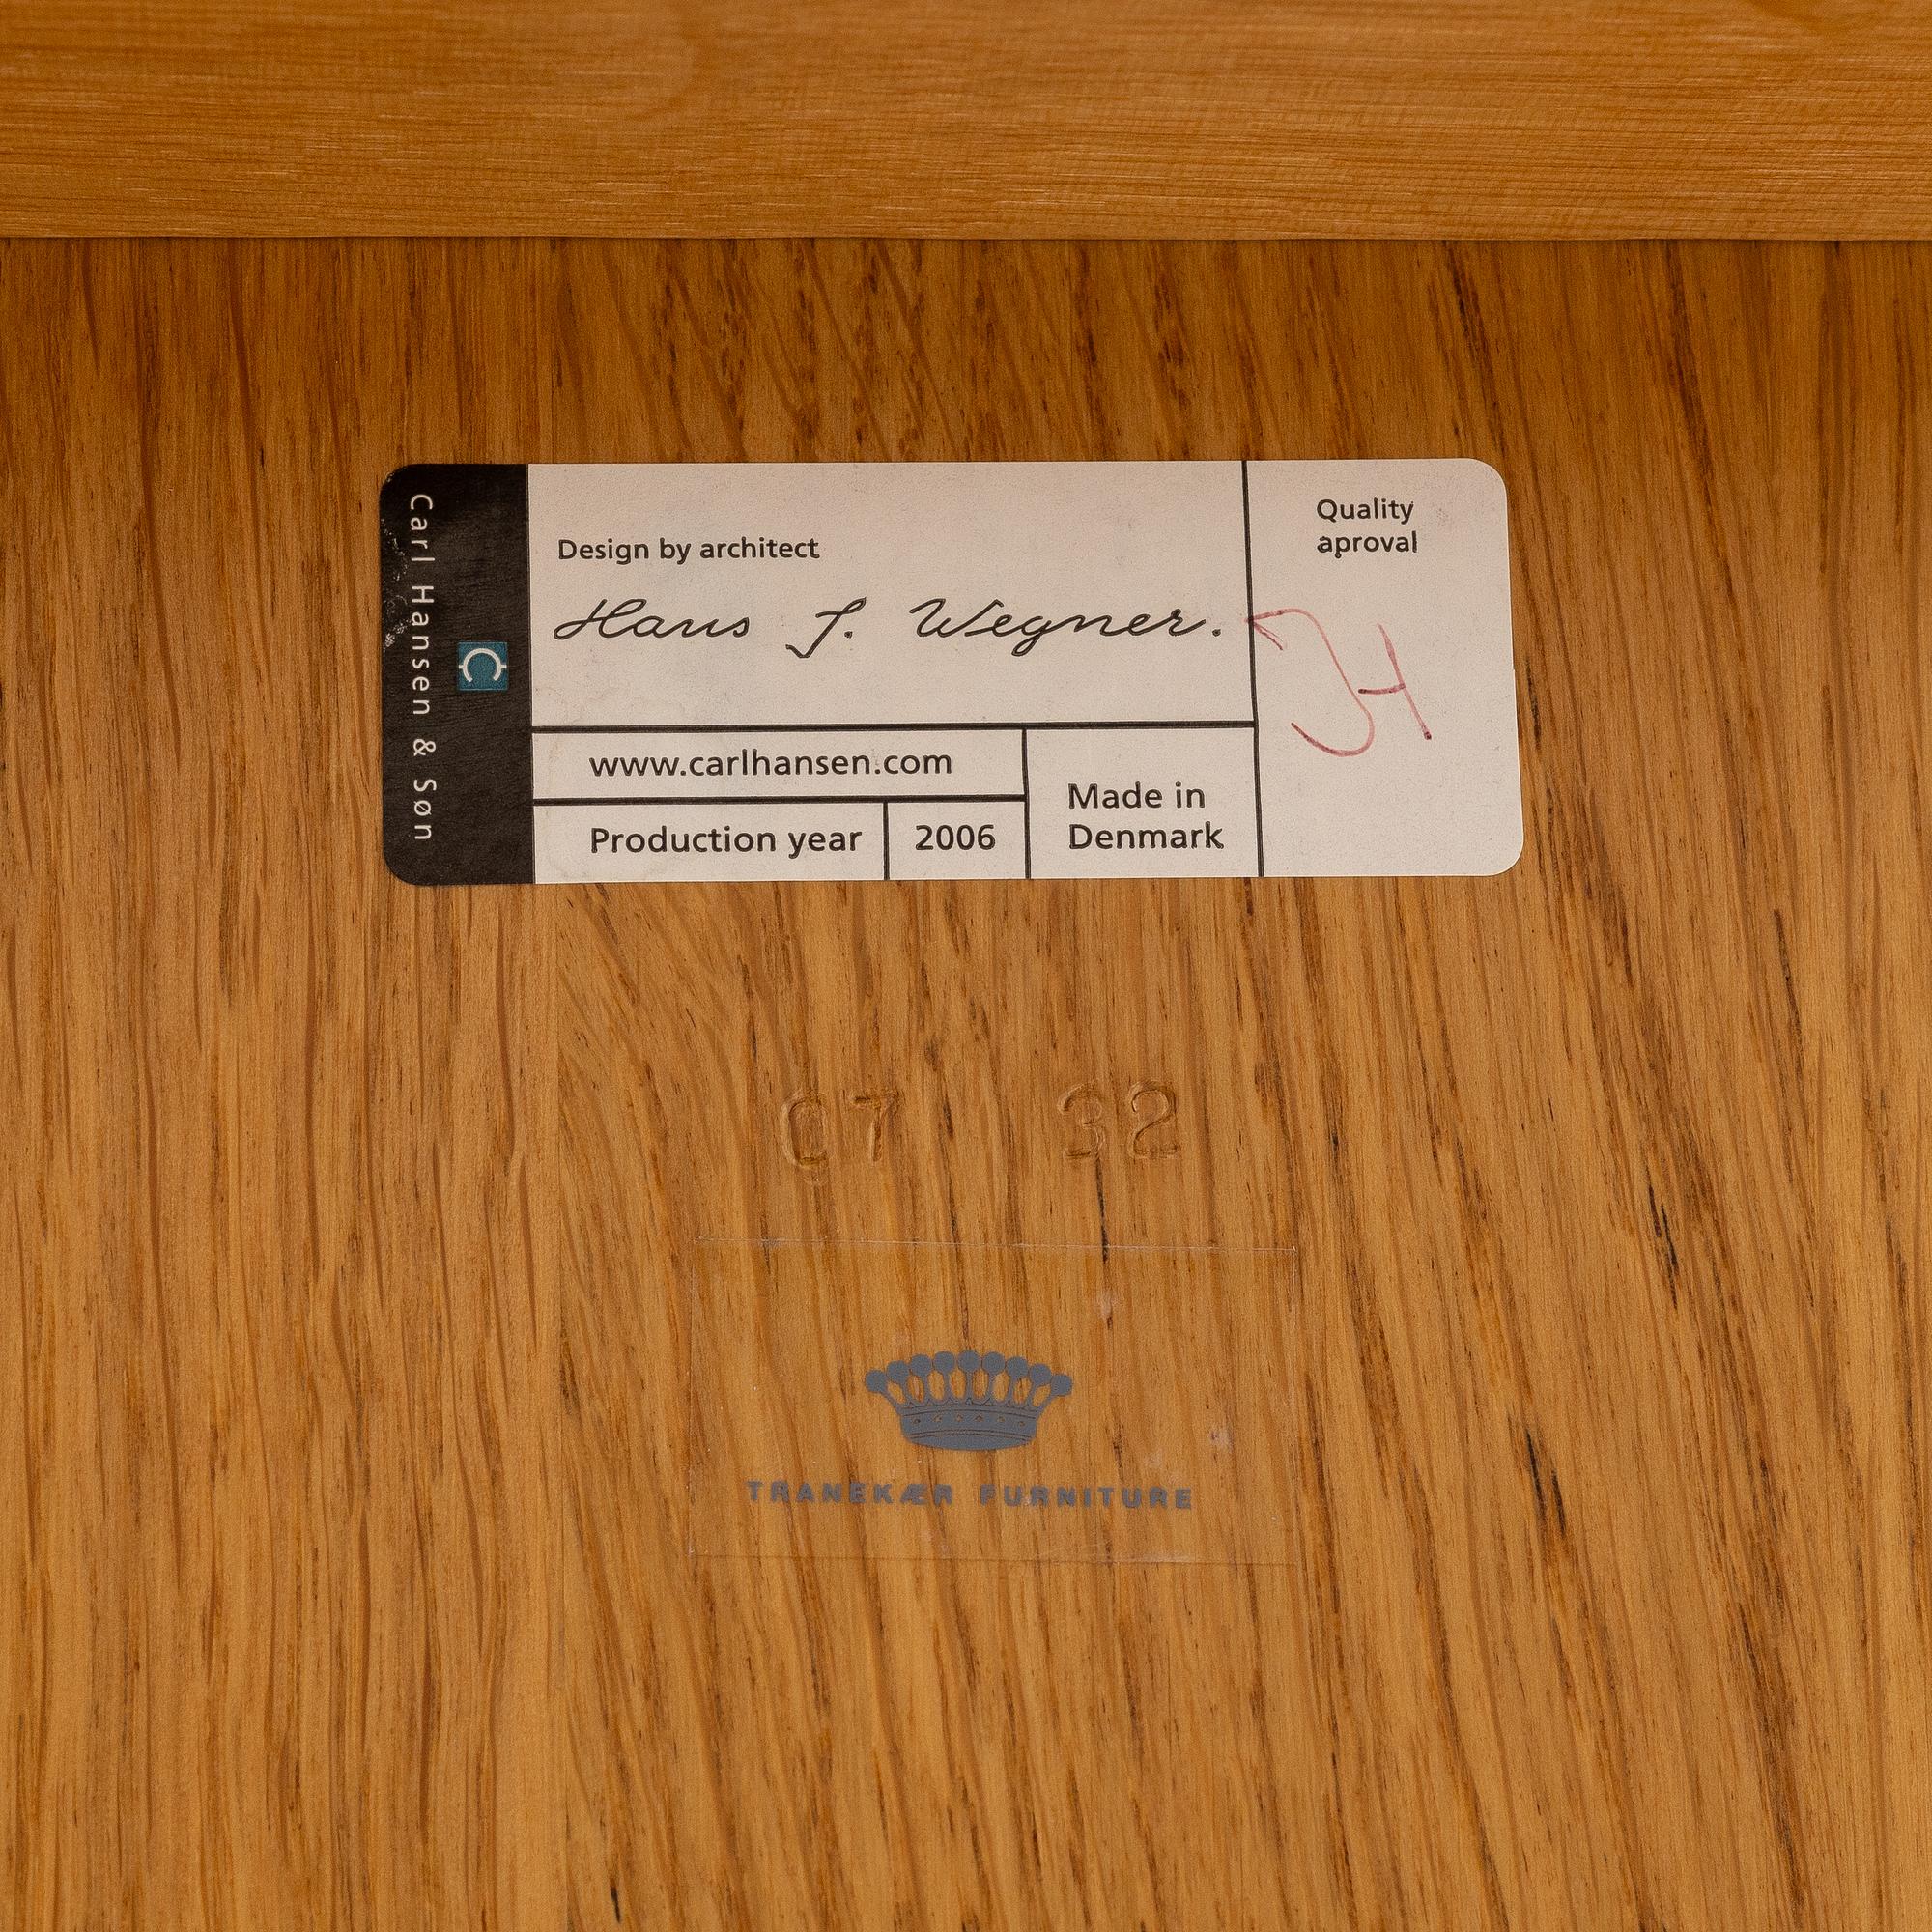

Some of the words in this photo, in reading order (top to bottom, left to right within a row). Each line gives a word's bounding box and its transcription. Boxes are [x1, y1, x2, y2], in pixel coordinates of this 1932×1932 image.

[1315, 496, 1415, 526] Quality
[409, 493, 436, 563] Carl
[557, 537, 650, 566] Design
[658, 536, 693, 566] by
[698, 536, 821, 560] architect
[1315, 530, 1419, 559] aproval
[552, 597, 752, 640] Hans
[411, 584, 436, 716] Hansen
[412, 737, 438, 758] &
[588, 747, 953, 778] www.carlhansen.com
[412, 778, 438, 842] Søn
[1066, 781, 1164, 810] Made
[1173, 781, 1207, 810] in
[589, 825, 777, 855] Production
[786, 829, 865, 861] year
[914, 823, 997, 852] 2006
[1067, 820, 1225, 850] Denmark
[746, 1479, 955, 1506] TRANEKÆR
[979, 1485, 1194, 1510] FURNITURE
